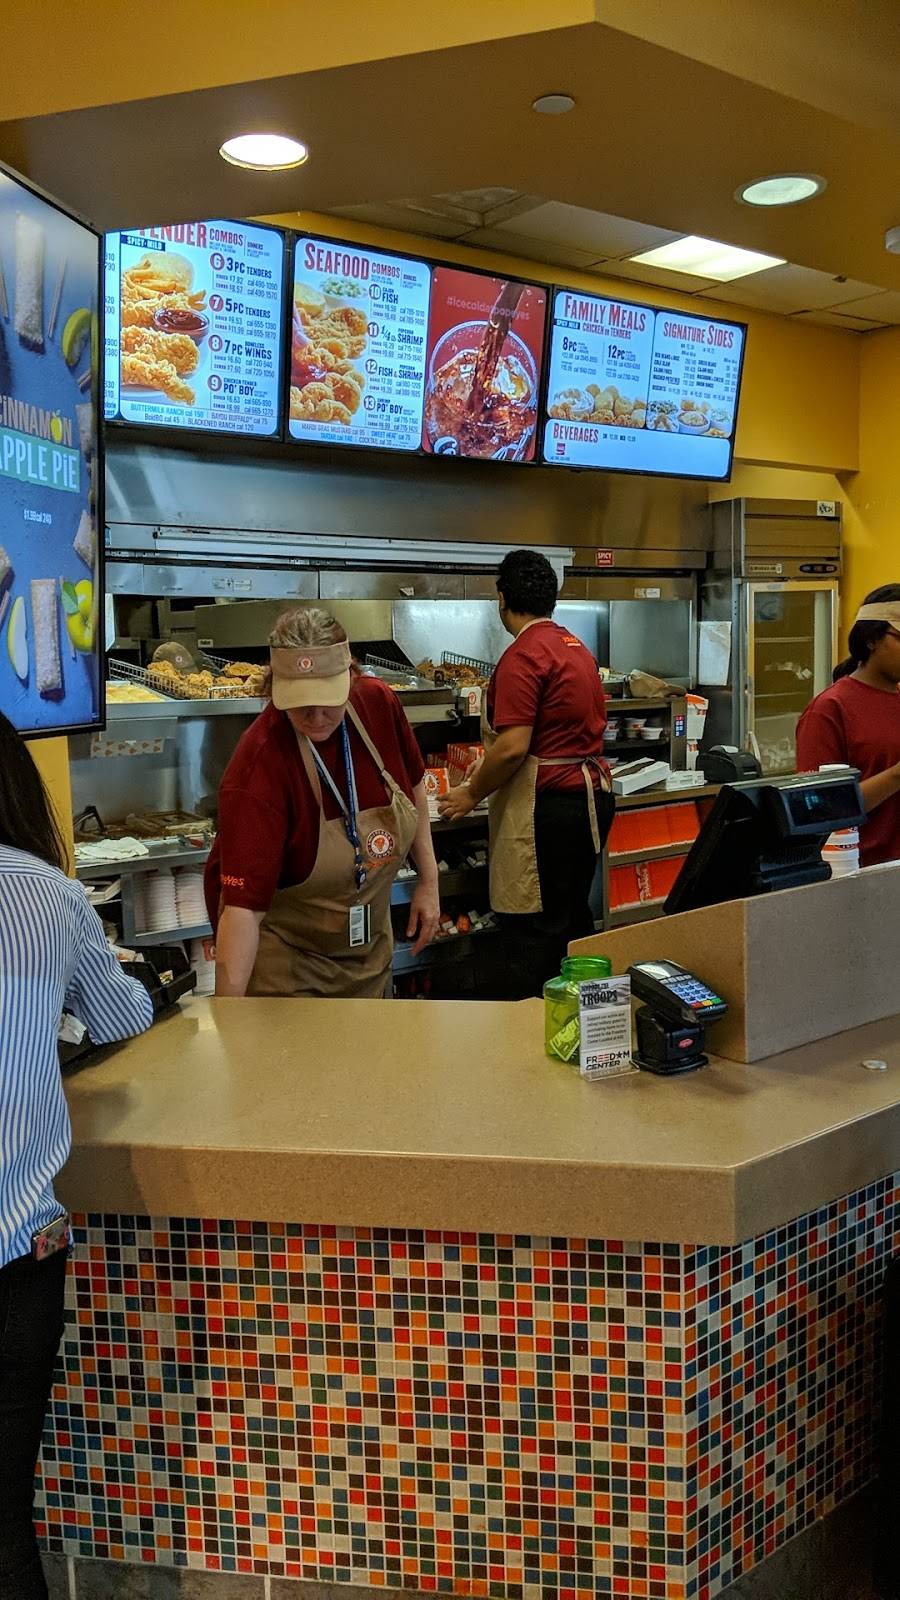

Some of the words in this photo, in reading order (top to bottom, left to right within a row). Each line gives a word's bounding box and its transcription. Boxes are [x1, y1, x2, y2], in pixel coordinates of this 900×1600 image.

[210, 228, 244, 246] COMBOS
[304, 242, 370, 280] SEAFOOD
[371, 262, 400, 279] COMBOS
[246, 266, 272, 278] TENDERS
[382, 292, 398, 304] FISH
[246, 306, 270, 318] TENDERS
[564, 294, 606, 325] FAMILY
[608, 304, 646, 332] MEALS
[582, 322, 604, 336] CHICKEN
[610, 328, 632, 340] TENDERS
[663, 322, 706, 344] SIGNATURE
[707, 324, 734, 349] SIDES
[398, 334, 424, 345] SHRIMP
[245, 348, 272, 360] WINGS
[378, 366, 393, 377] FISH
[398, 370, 422, 380] SHRIMP
[239, 386, 254, 396] BOY
[130, 404, 164, 414] BUTTERMILK
[390, 404, 403, 414] BOY
[188, 418, 218, 428] BLACKENED
[218, 421, 236, 430] RANCH
[554, 422, 600, 444] BEVERAGES
[582, 990, 618, 1006] TROOPS
[586, 1060, 620, 1070] CENTER
